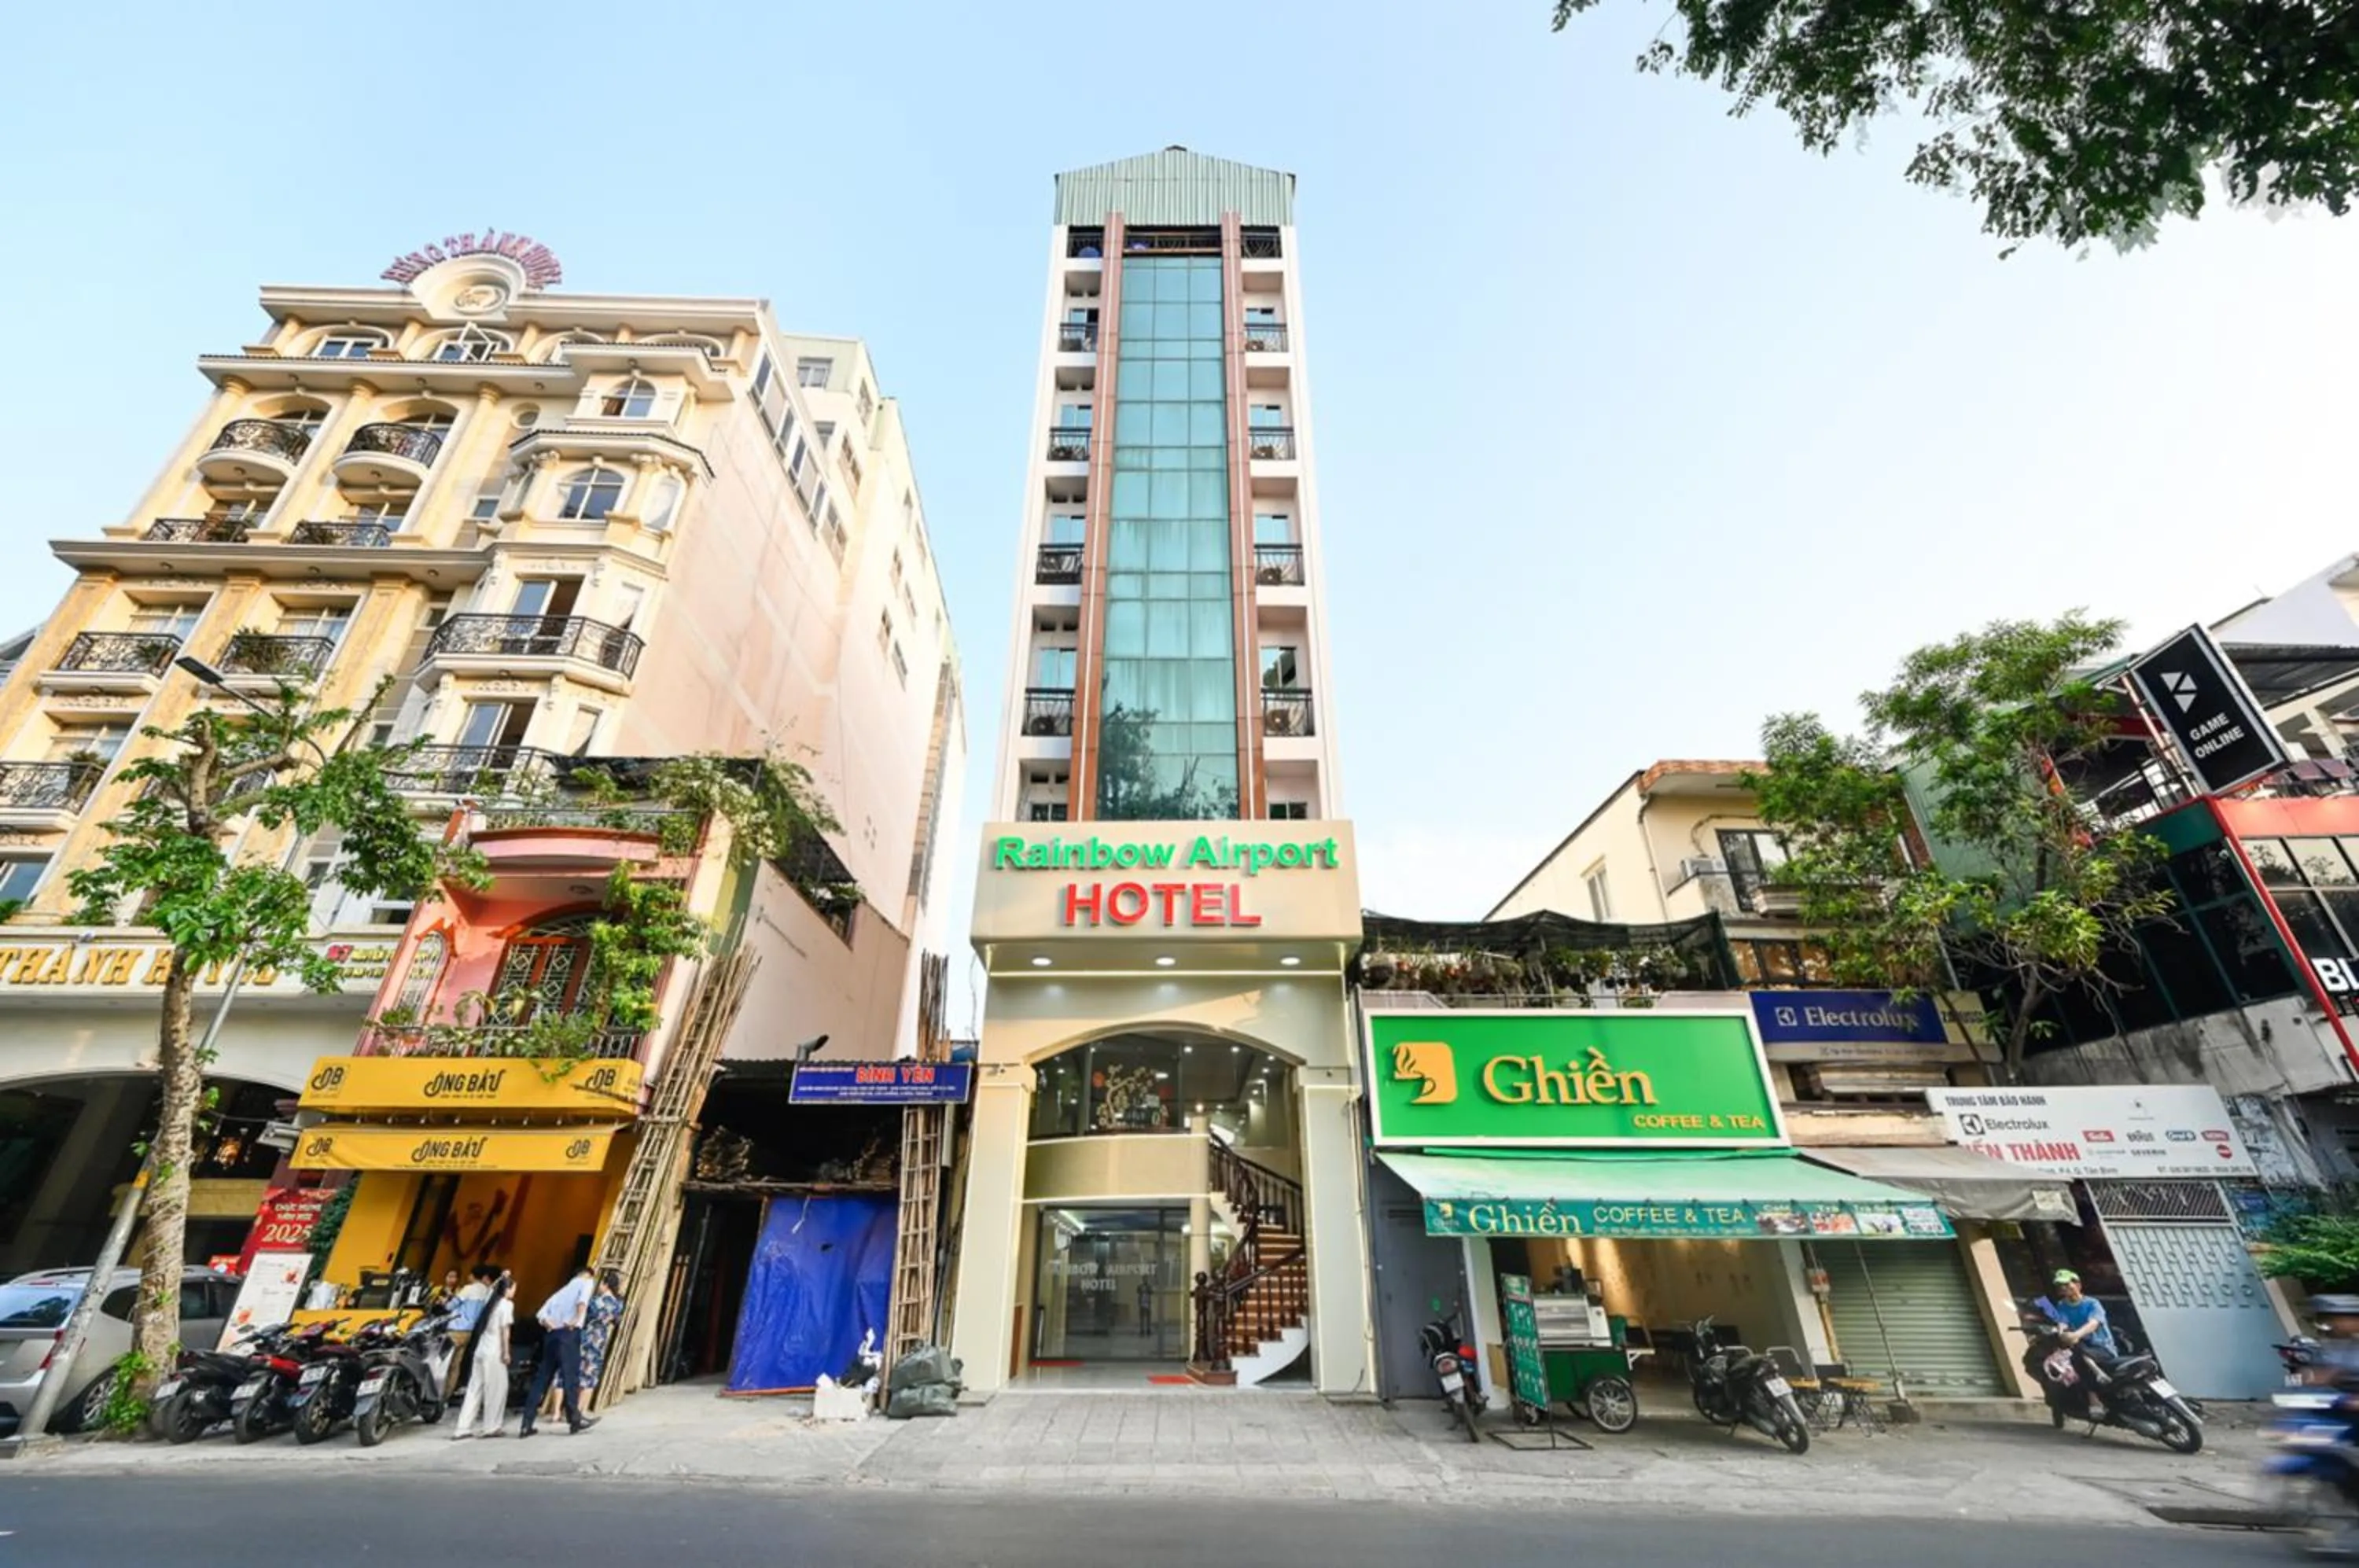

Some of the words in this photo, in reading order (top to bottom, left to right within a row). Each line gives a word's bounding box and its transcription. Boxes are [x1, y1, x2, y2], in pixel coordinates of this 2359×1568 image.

[2190, 712, 2230, 740] GAME
[2195, 726, 2245, 759] ONLINE
[995, 836, 1176, 870] Rainbow
[1187, 835, 1339, 876] Airport
[1064, 882, 1262, 926] HOTEL
[1804, 1006, 1920, 1027] Electrolux
[1482, 1047, 1659, 1105] Ghiền
[1634, 1114, 1703, 1129] COFFEE
[1710, 1114, 1723, 1128] &
[1727, 1115, 1765, 1129] TEA
[1984, 1117, 2049, 1131] Electrolux
[1593, 1206, 1679, 1224] COFFEE
[1685, 1208, 1698, 1224] &
[1702, 1208, 1746, 1224] TEA
[261, 1224, 314, 1244] 2025
[1081, 1278, 1117, 1291] HOTEL
